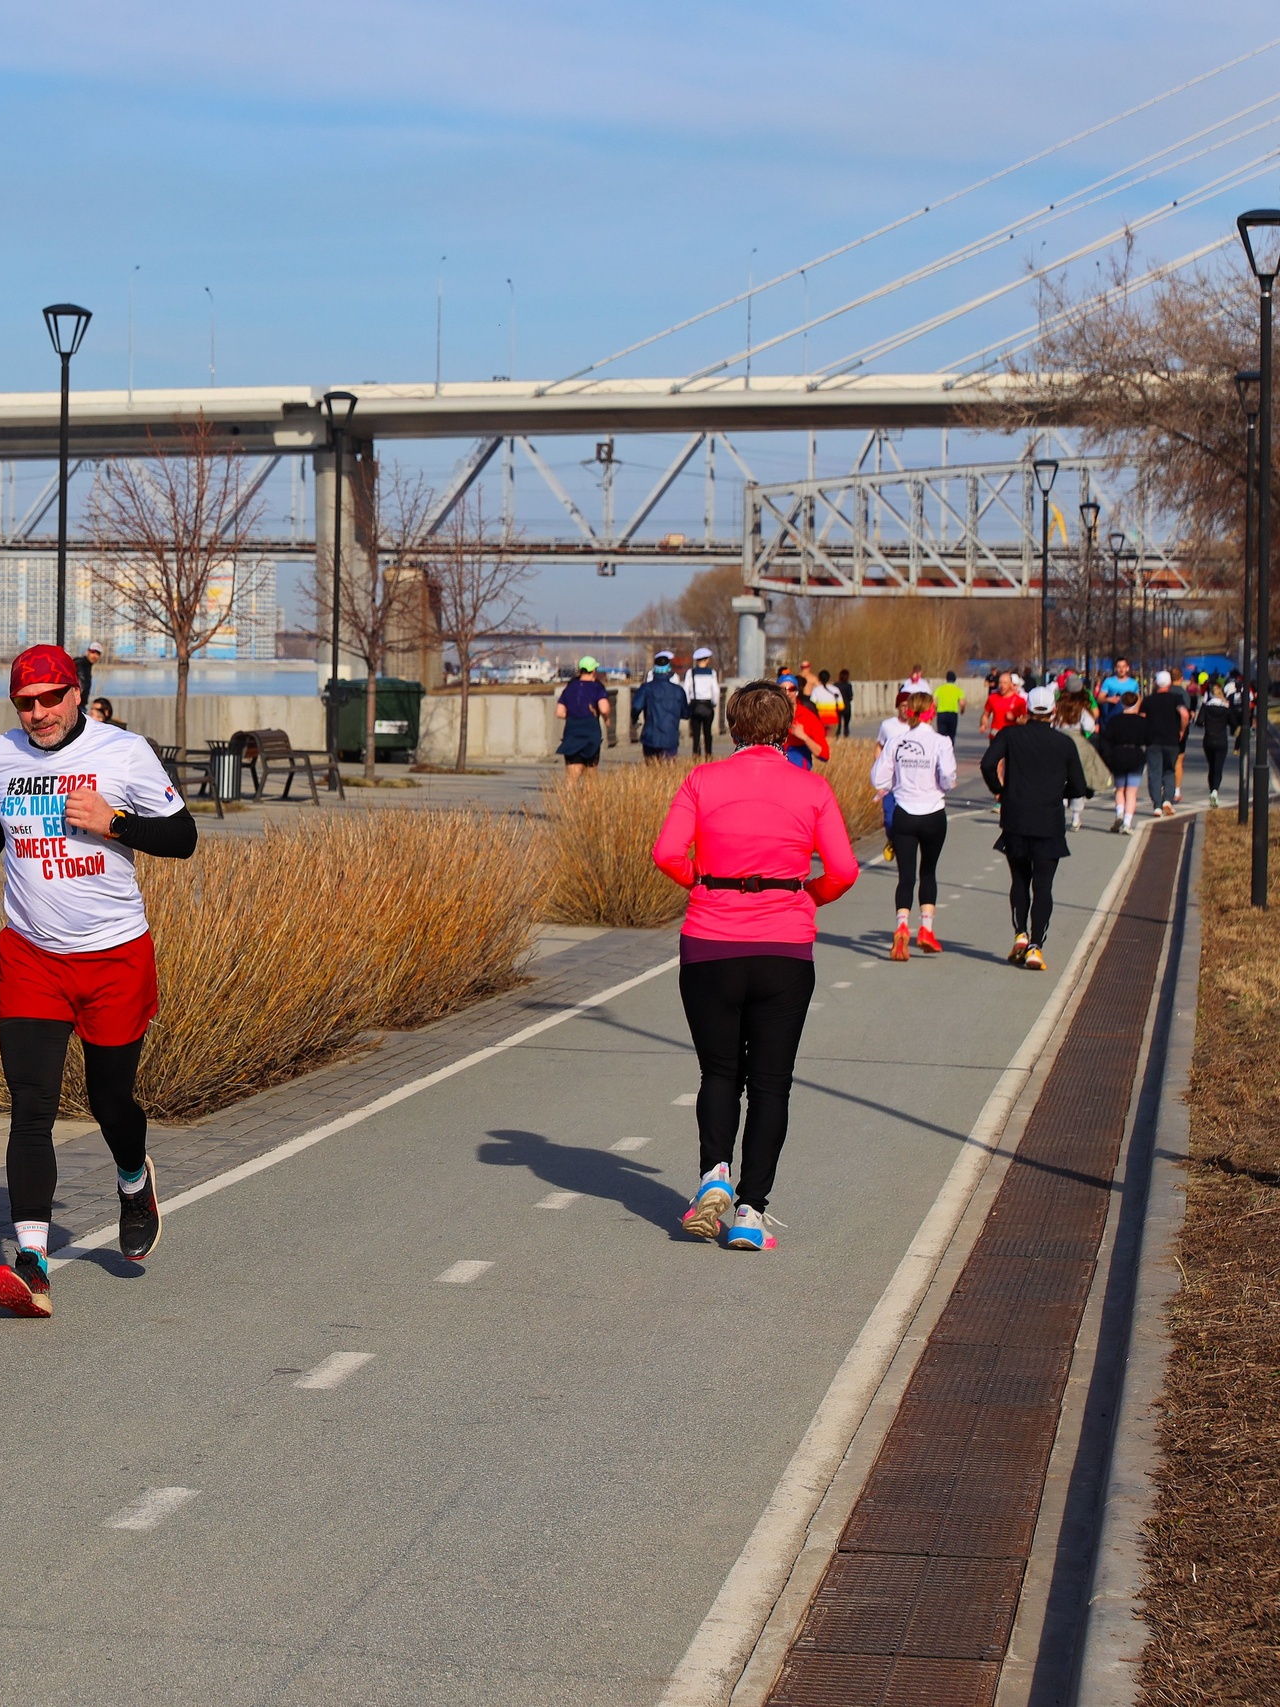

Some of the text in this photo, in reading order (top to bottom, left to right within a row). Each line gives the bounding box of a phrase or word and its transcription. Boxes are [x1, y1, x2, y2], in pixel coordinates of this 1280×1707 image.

[7, 774, 97, 795] #ЗАБЕГ2025
[1, 796, 27, 816] 45%
[42, 816, 88, 836] БЕГ
[15, 837, 68, 858] ВМЕСТЕ
[42, 852, 105, 880] С ТОБОЙ
